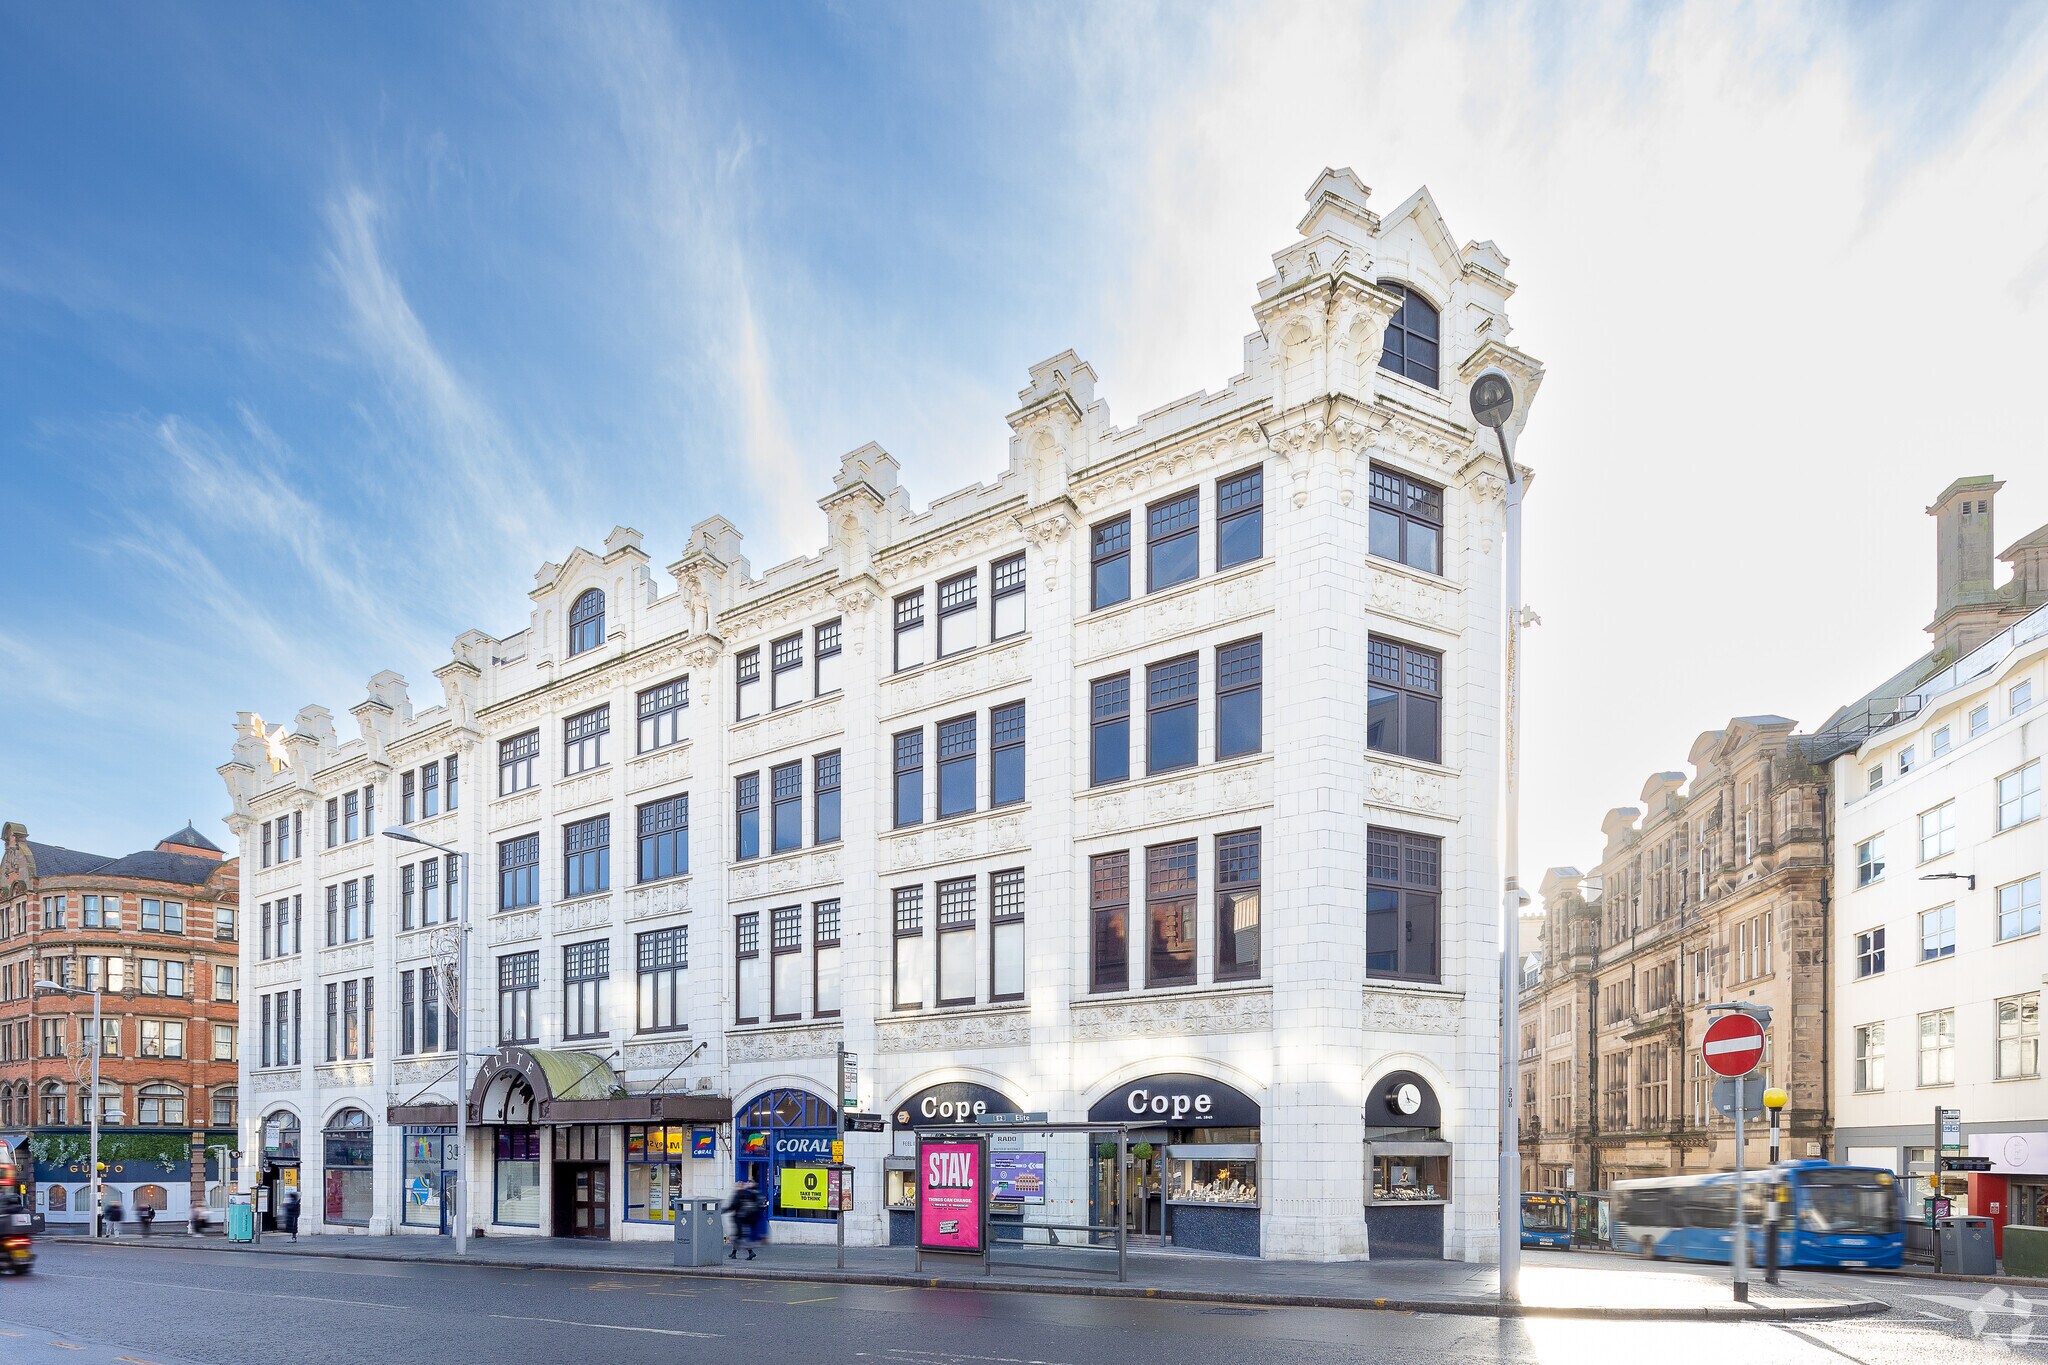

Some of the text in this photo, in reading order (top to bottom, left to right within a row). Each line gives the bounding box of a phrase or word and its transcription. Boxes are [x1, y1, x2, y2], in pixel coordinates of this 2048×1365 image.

[483, 1051, 534, 1078] ELITE
[921, 1096, 987, 1123] Cope
[1127, 1089, 1212, 1120] Cope
[775, 1138, 830, 1153] CORAL
[69, 1164, 124, 1173] GUTO
[929, 1152, 974, 1187] STAY.
